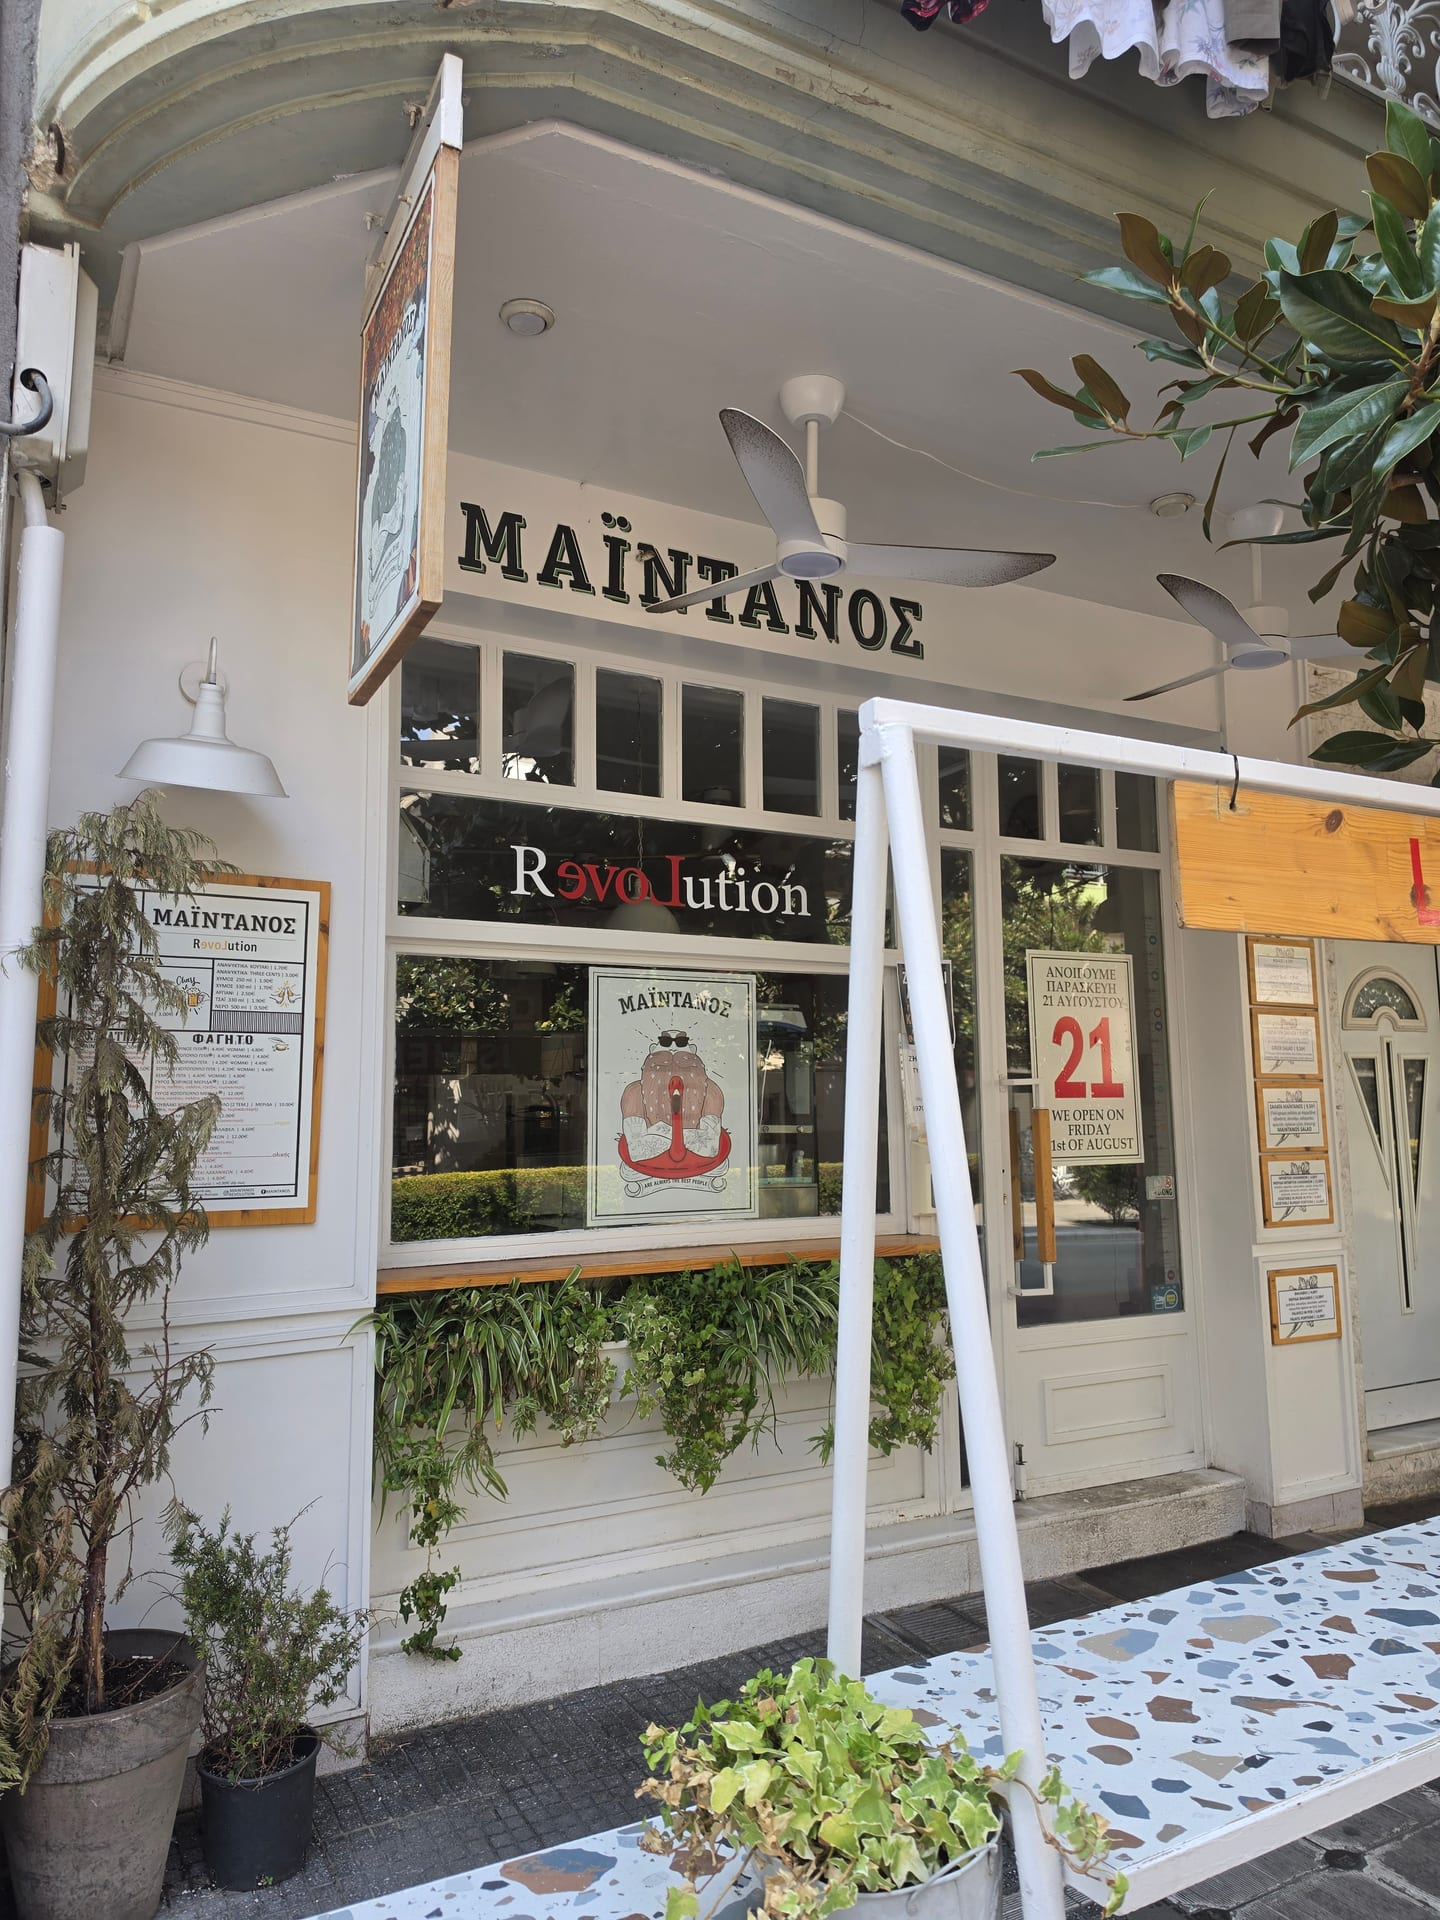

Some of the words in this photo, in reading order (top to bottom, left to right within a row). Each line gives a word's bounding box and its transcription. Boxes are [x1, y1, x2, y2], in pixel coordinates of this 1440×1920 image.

[458, 502, 924, 660] ΜΑΪΝΤΑΝΟΣ
[153, 906, 296, 934] ΜΑΪΝΤΑΝΟΣ
[1046, 966, 1116, 980] ΑΝΟΙΓΟΥΜΕ
[1047, 980, 1117, 994] ΠΑΡΑΣΚΕΥΗ
[618, 987, 732, 1018] ΜΑΪΝΤΑΝΟΣ
[1043, 995, 1054, 1007] 21
[1057, 995, 1124, 1009] ΑΥΓΟΥΣΤΟΥ
[192, 1034, 254, 1045] ΦΑΓΗΤΟ
[1052, 1016, 1124, 1098] 21
[1052, 1109, 1070, 1122] WE
[1073, 1109, 1104, 1122] OPEN
[1107, 1108, 1124, 1121] ON
[1068, 1123, 1111, 1136] FRIDAY
[1068, 1139, 1083, 1150] OF
[1086, 1137, 1134, 1150] AUGUST
